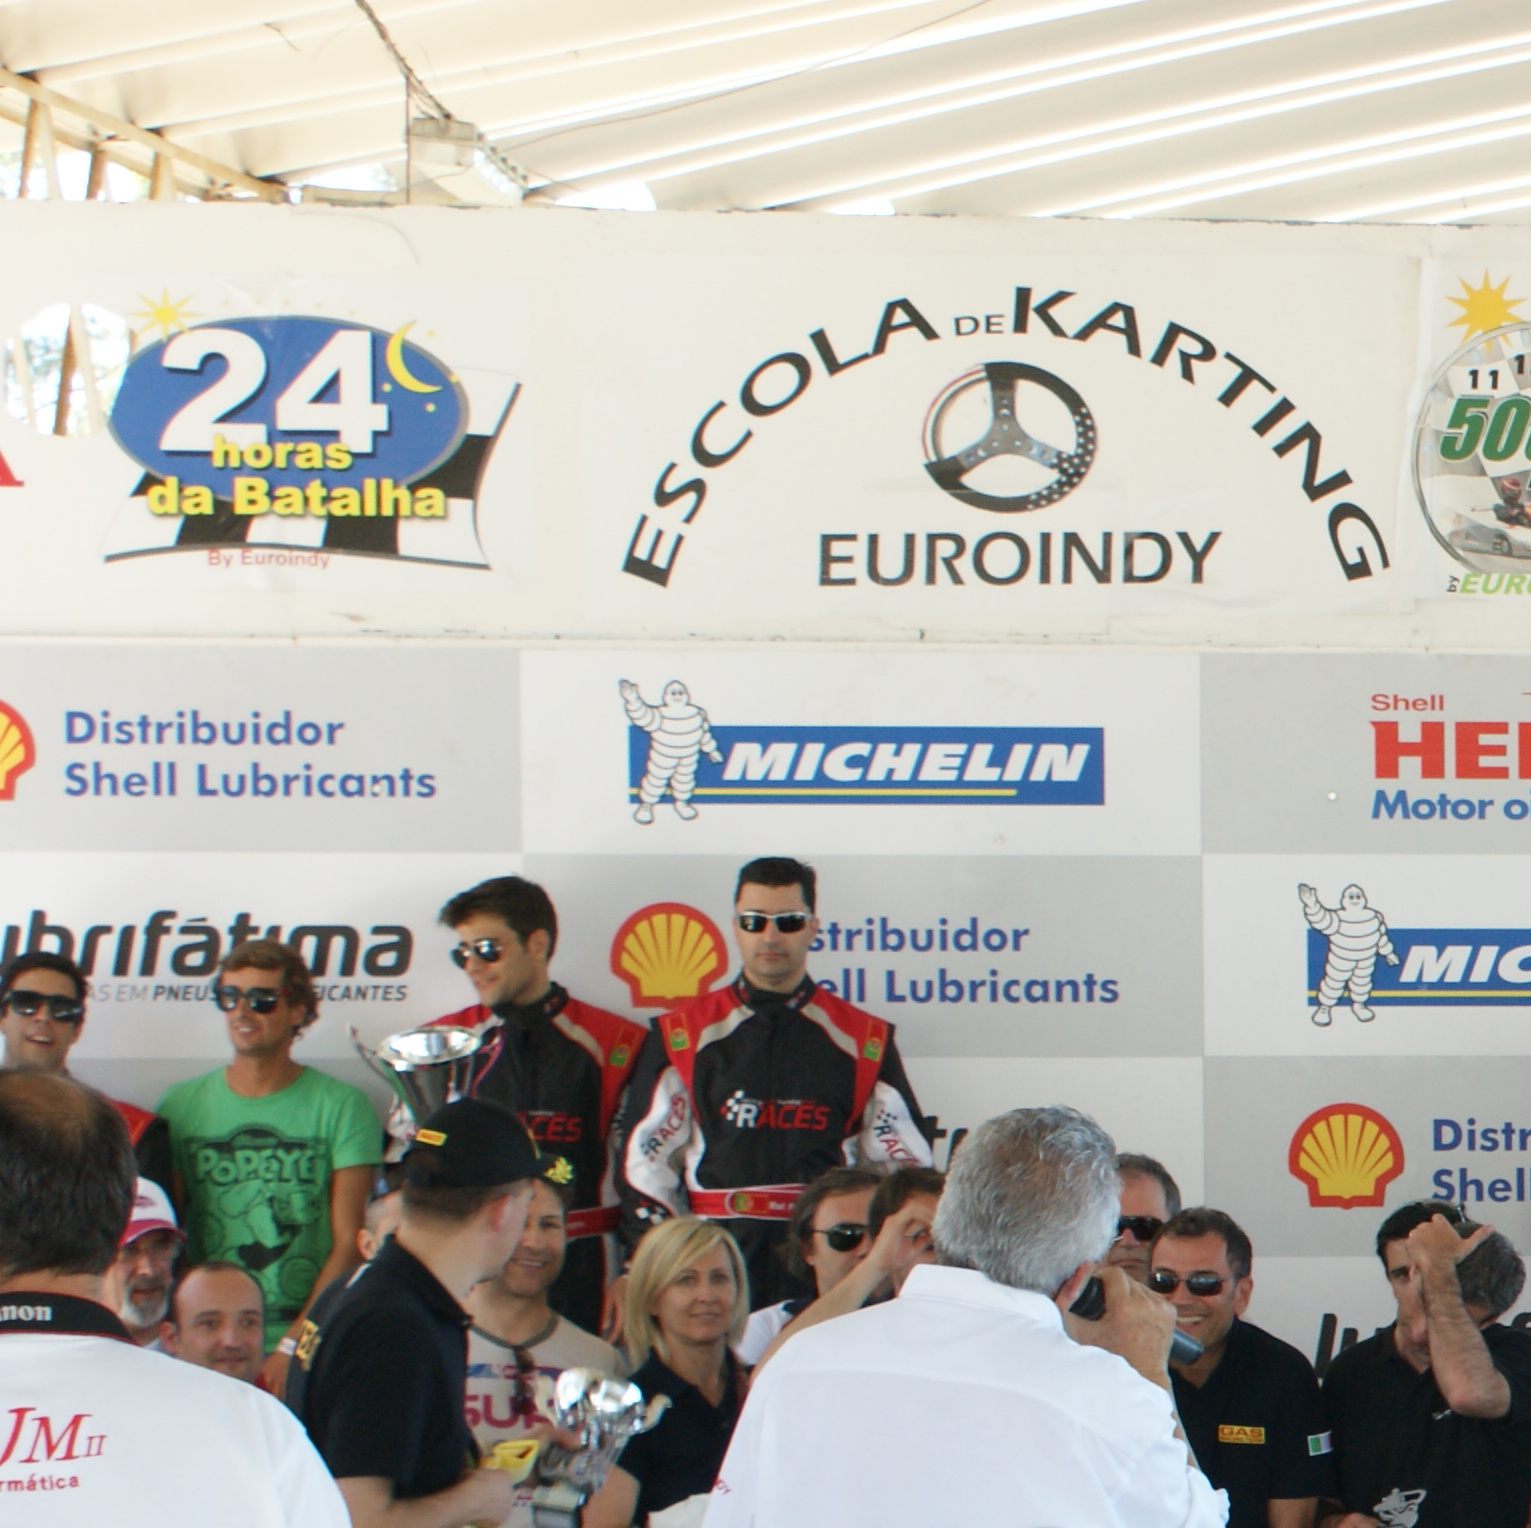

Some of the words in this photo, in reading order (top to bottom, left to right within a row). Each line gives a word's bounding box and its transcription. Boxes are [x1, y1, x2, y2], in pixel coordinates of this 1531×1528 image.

[159, 327, 389, 453] 24
[1469, 370, 1499, 389] 11
[212, 434, 352, 469] horas
[622, 297, 940, 587] ESCOLA
[954, 315, 1004, 336] DE
[1012, 287, 1390, 581] KARTING
[148, 476, 213, 515] da
[233, 476, 445, 517] Batalha
[208, 550, 232, 567] By
[241, 549, 330, 568] Euroindy
[819, 531, 1222, 586] EUROINDY
[1370, 694, 1444, 712] Shell
[65, 711, 345, 745] Distribuidor
[722, 742, 1090, 782] MICHELIN
[65, 762, 176, 798] Shell
[200, 762, 436, 798] Lubricants
[1371, 790, 1494, 820] Motor
[808, 917, 1030, 951] stribuidor
[886, 968, 1119, 1003] Lubricants
[736, 1102, 830, 1131] RACES
